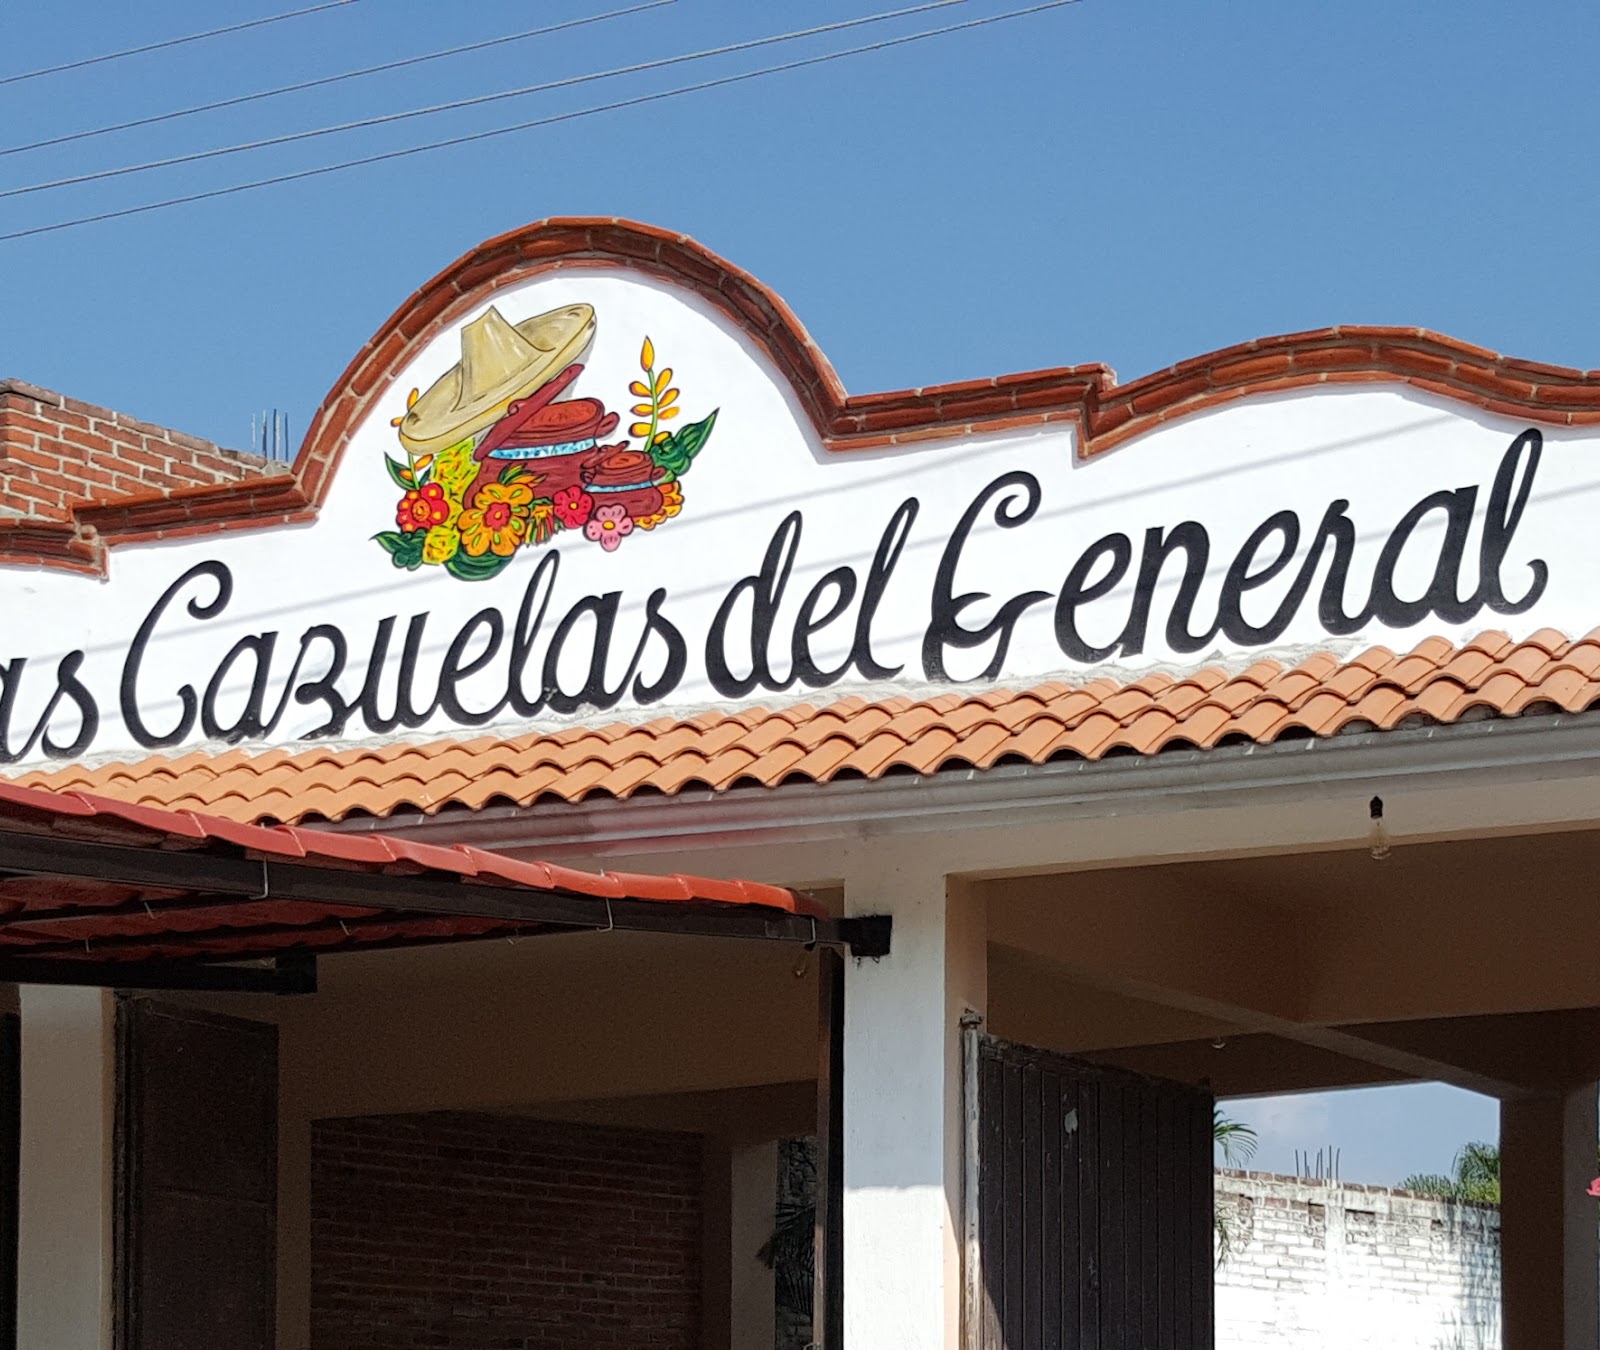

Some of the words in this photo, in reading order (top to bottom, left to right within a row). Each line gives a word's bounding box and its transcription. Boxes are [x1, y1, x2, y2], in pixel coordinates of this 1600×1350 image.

[119, 550, 687, 748] Cazuelas
[705, 497, 919, 699] del
[922, 428, 1548, 684] General
